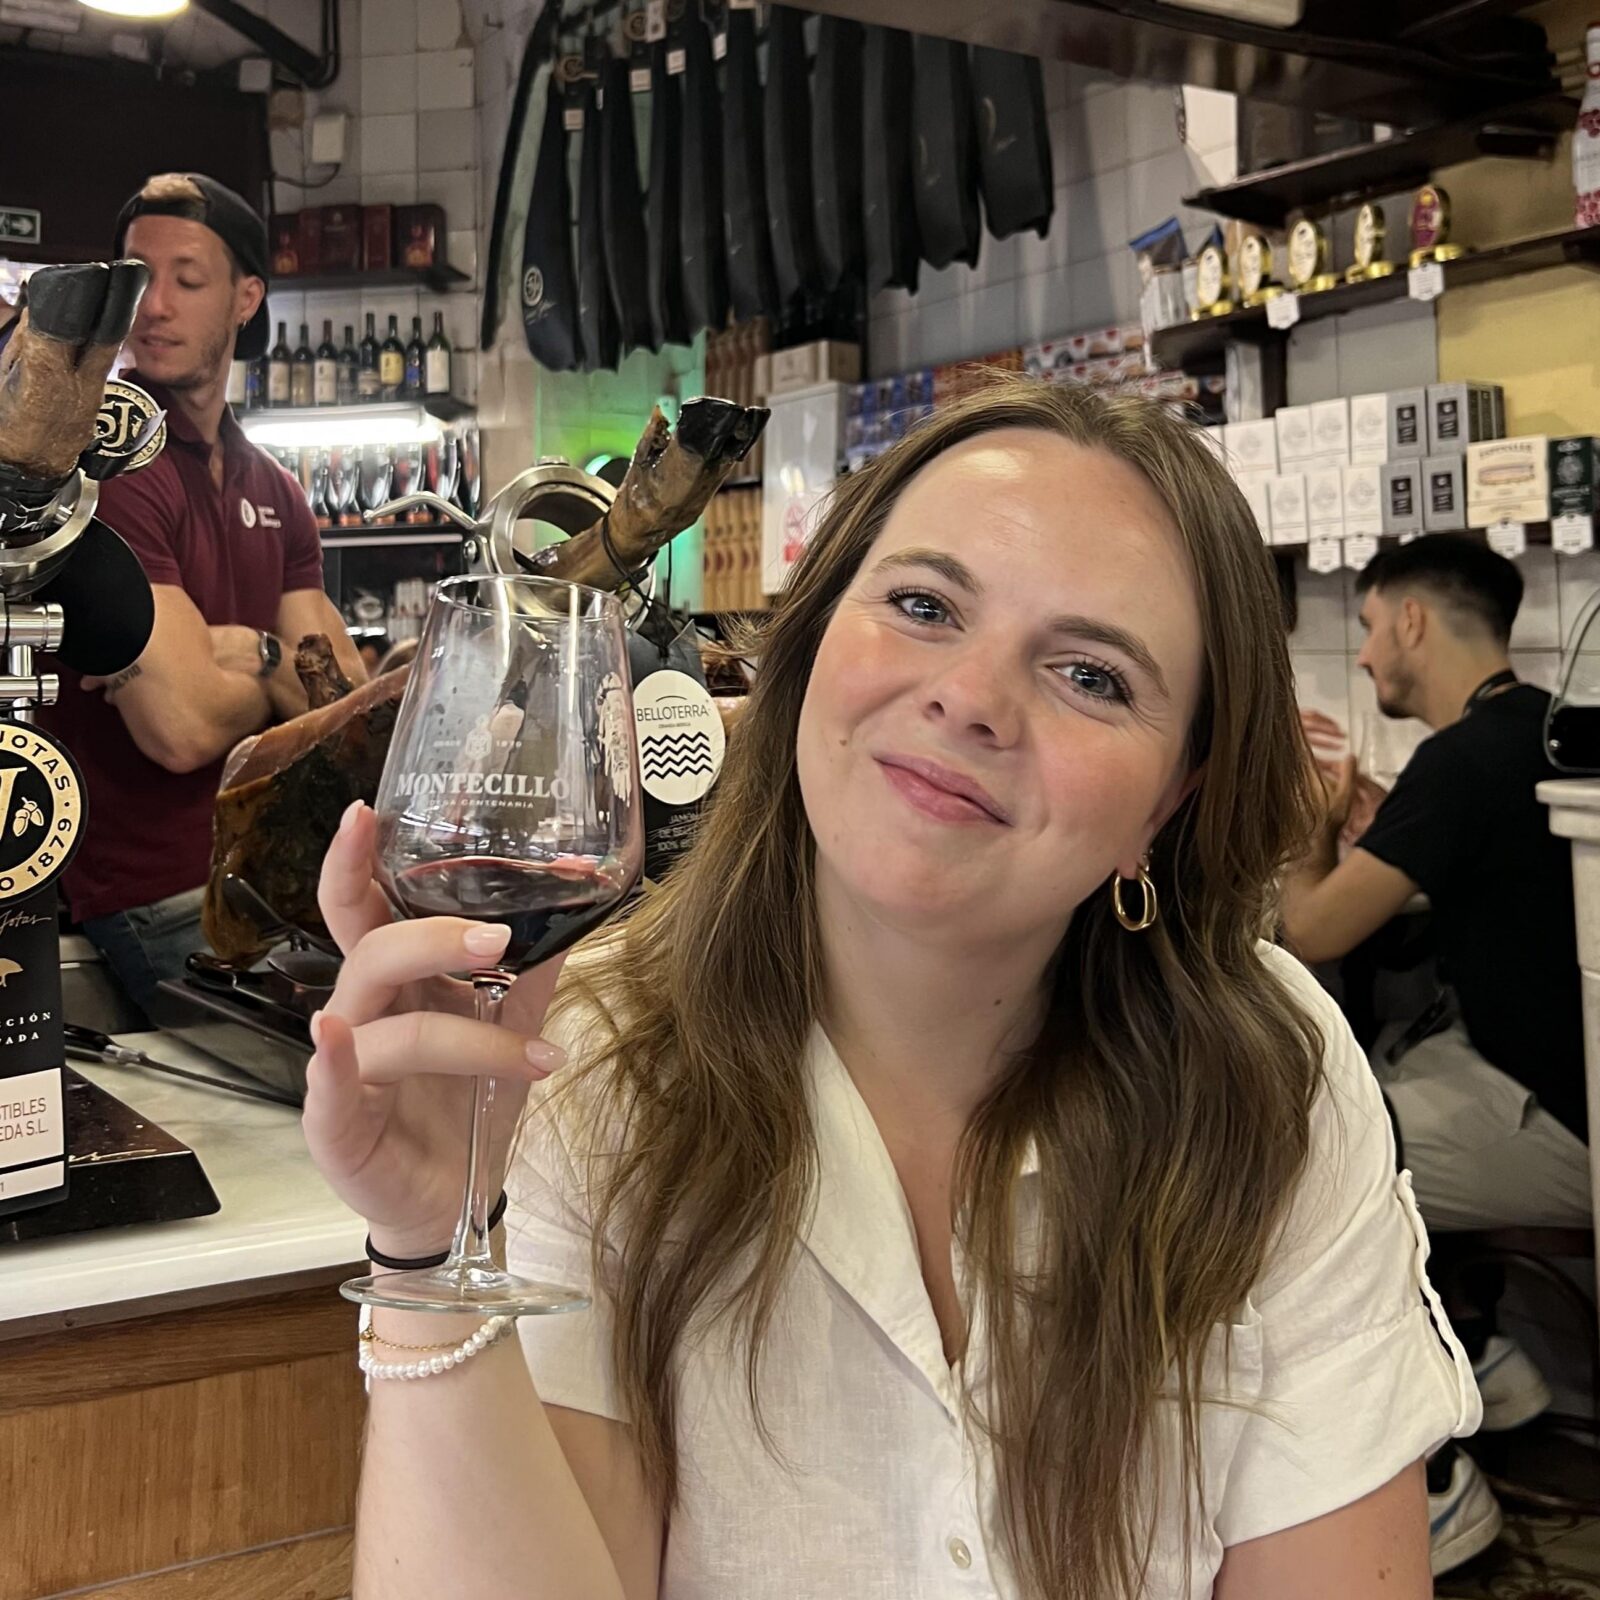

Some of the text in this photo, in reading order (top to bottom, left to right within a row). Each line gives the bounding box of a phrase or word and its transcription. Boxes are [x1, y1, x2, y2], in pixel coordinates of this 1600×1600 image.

[636, 705, 709, 721] BELLOTERRA
[395, 772, 571, 800] MONTECILLO
[26, 818, 72, 878] 1879
[0, 1012, 51, 1028] CIÓN
[0, 1031, 40, 1045] ADA
[0, 1097, 47, 1120] TIBLES
